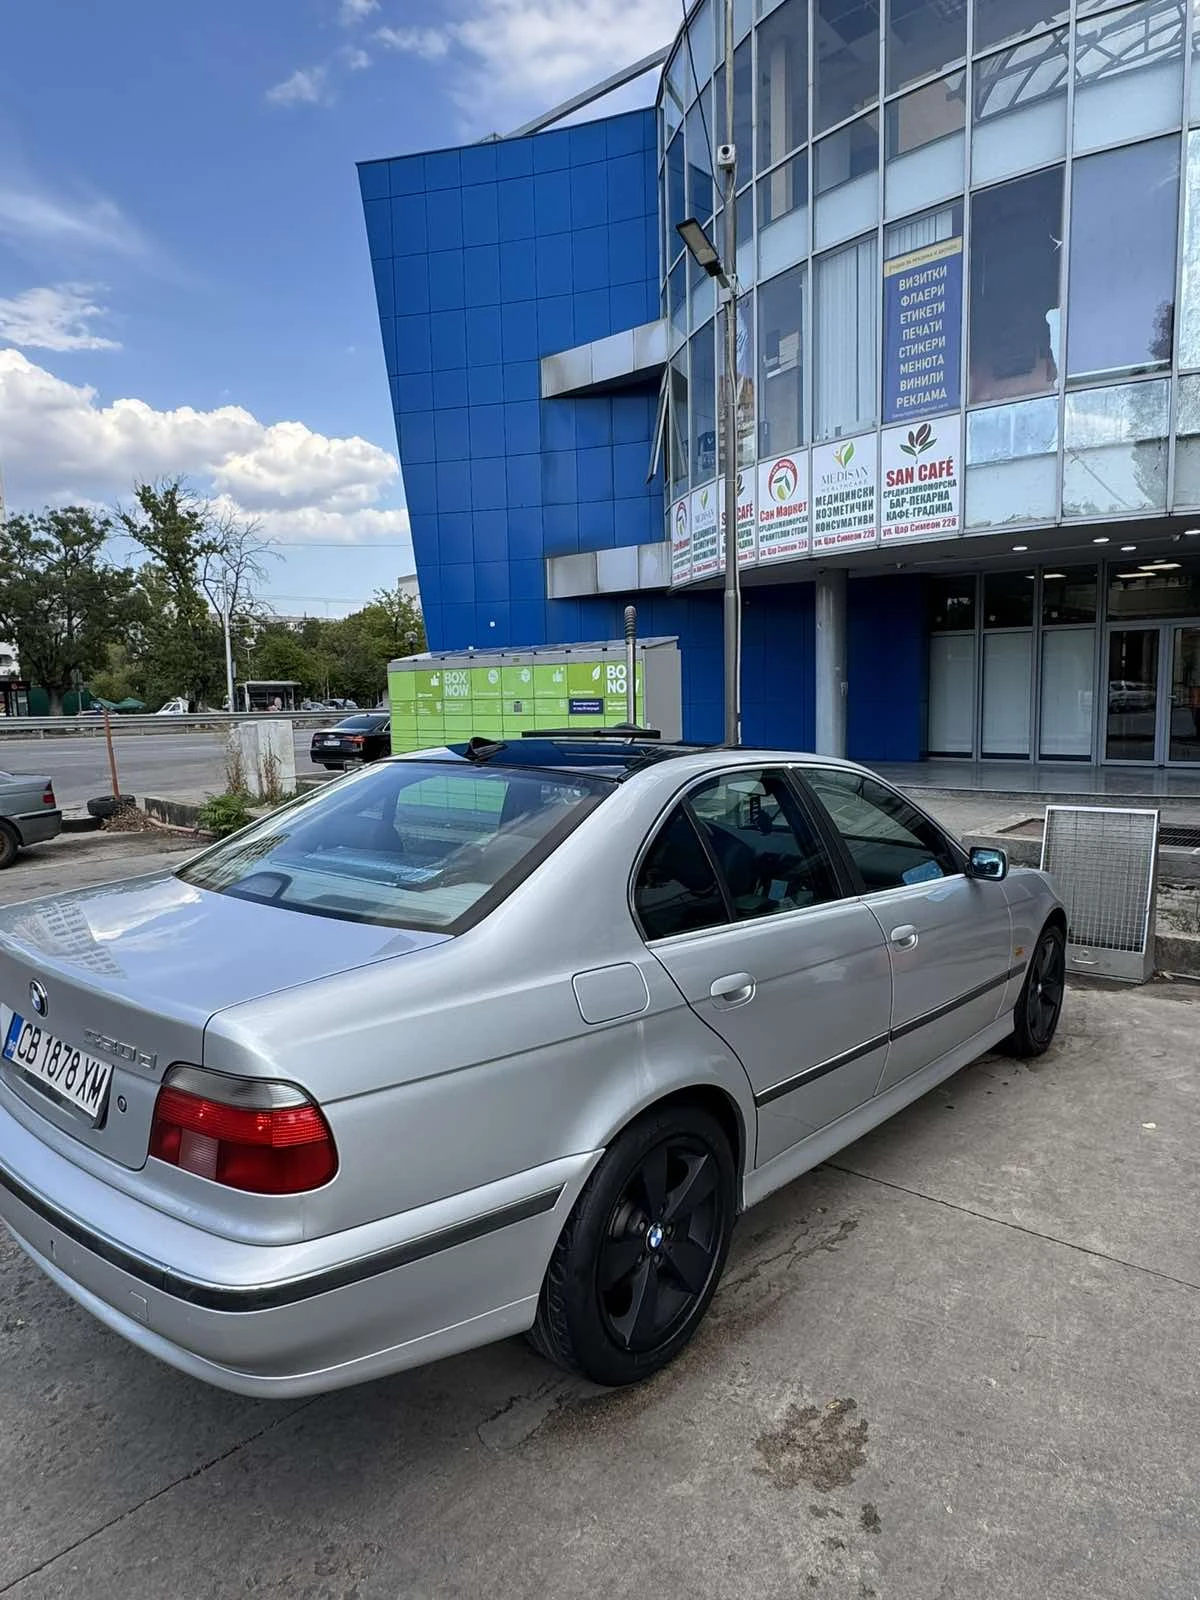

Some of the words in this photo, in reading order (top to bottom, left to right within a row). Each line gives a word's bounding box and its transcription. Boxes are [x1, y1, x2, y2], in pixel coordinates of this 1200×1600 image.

[899, 264, 947, 291] ВИЗИТКИ
[900, 283, 945, 306] ФЛАЕРИ
[900, 301, 945, 325] ЕТИКЕТИ
[902, 319, 943, 341] ПЕЧАТИ
[898, 336, 946, 358] СТИКЕРИ
[900, 353, 944, 375] МЕНЮТА
[900, 370, 944, 392] ВИНИЛИ
[896, 387, 947, 408] РЕКЛАМА
[886, 466, 914, 487] SAN
[918, 455, 954, 482] CAFÉ
[815, 485, 875, 508] МЕДИЦИНСКИ
[883, 479, 957, 499] СРЕДИЗЕМНОМОРСКА
[889, 490, 950, 509] БАР-ПЕКАРНА
[760, 510, 775, 522] Сан
[815, 499, 874, 520] КОЗМЕТИЧНИ
[886, 502, 953, 521] КАФЕ-ГРАДИНА
[815, 513, 874, 533] КОНСУМАТИВИ
[444, 671, 467, 685] BOX
[606, 664, 627, 679] BO
[445, 684, 469, 697] NOW
[17, 1023, 42, 1064] CB
[41, 1035, 81, 1090] 1878
[76, 1057, 108, 1109] XM
